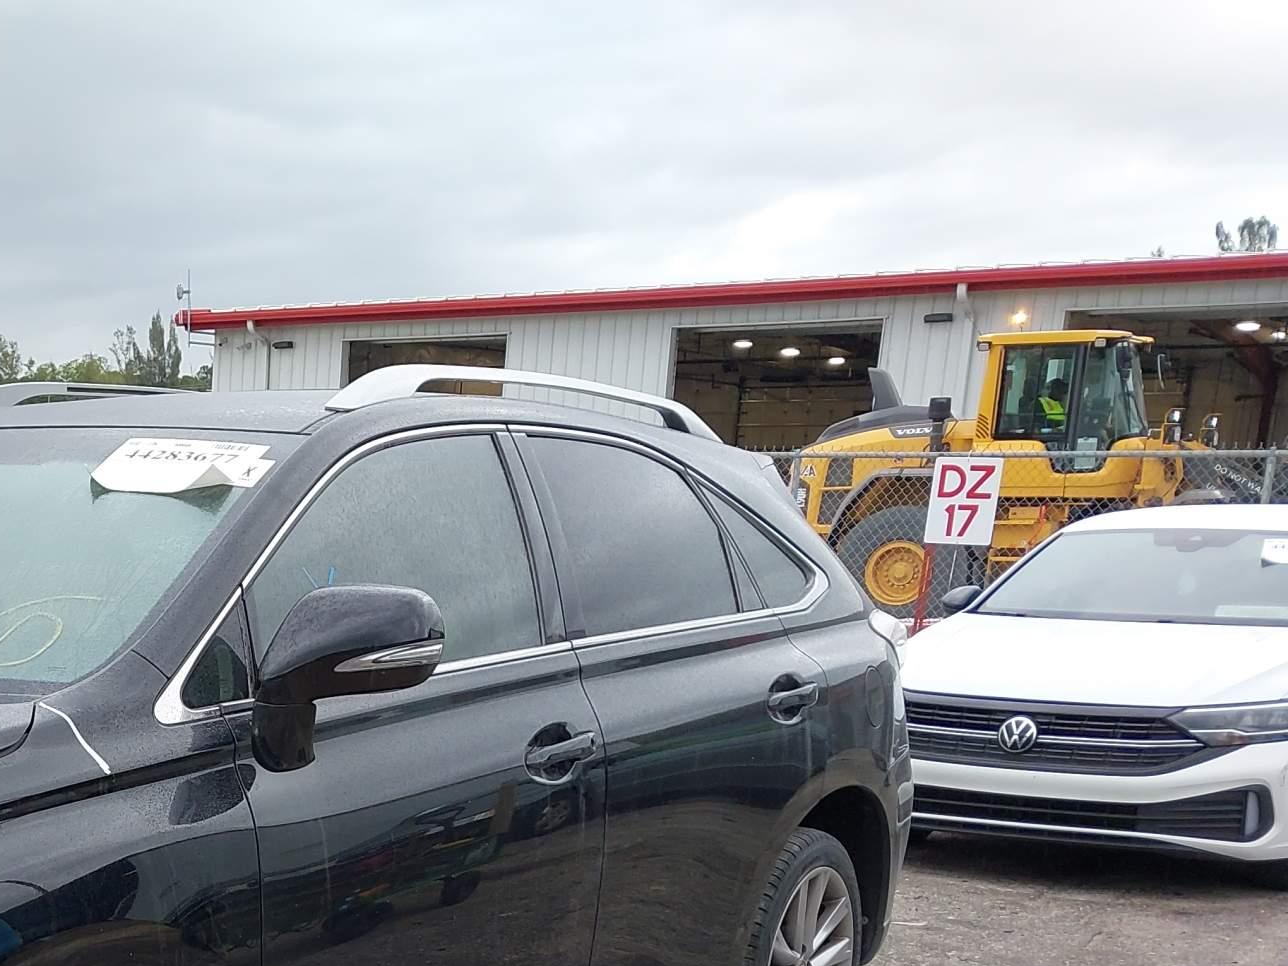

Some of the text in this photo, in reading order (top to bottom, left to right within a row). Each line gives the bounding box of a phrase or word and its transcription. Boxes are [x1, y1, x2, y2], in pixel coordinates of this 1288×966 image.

[895, 426, 933, 435] VOLV
[125, 449, 240, 464] 44283677
[937, 464, 996, 499] DZ
[1214, 463, 1228, 475] DO
[1226, 471, 1247, 484] NOT
[945, 504, 979, 537] 17
